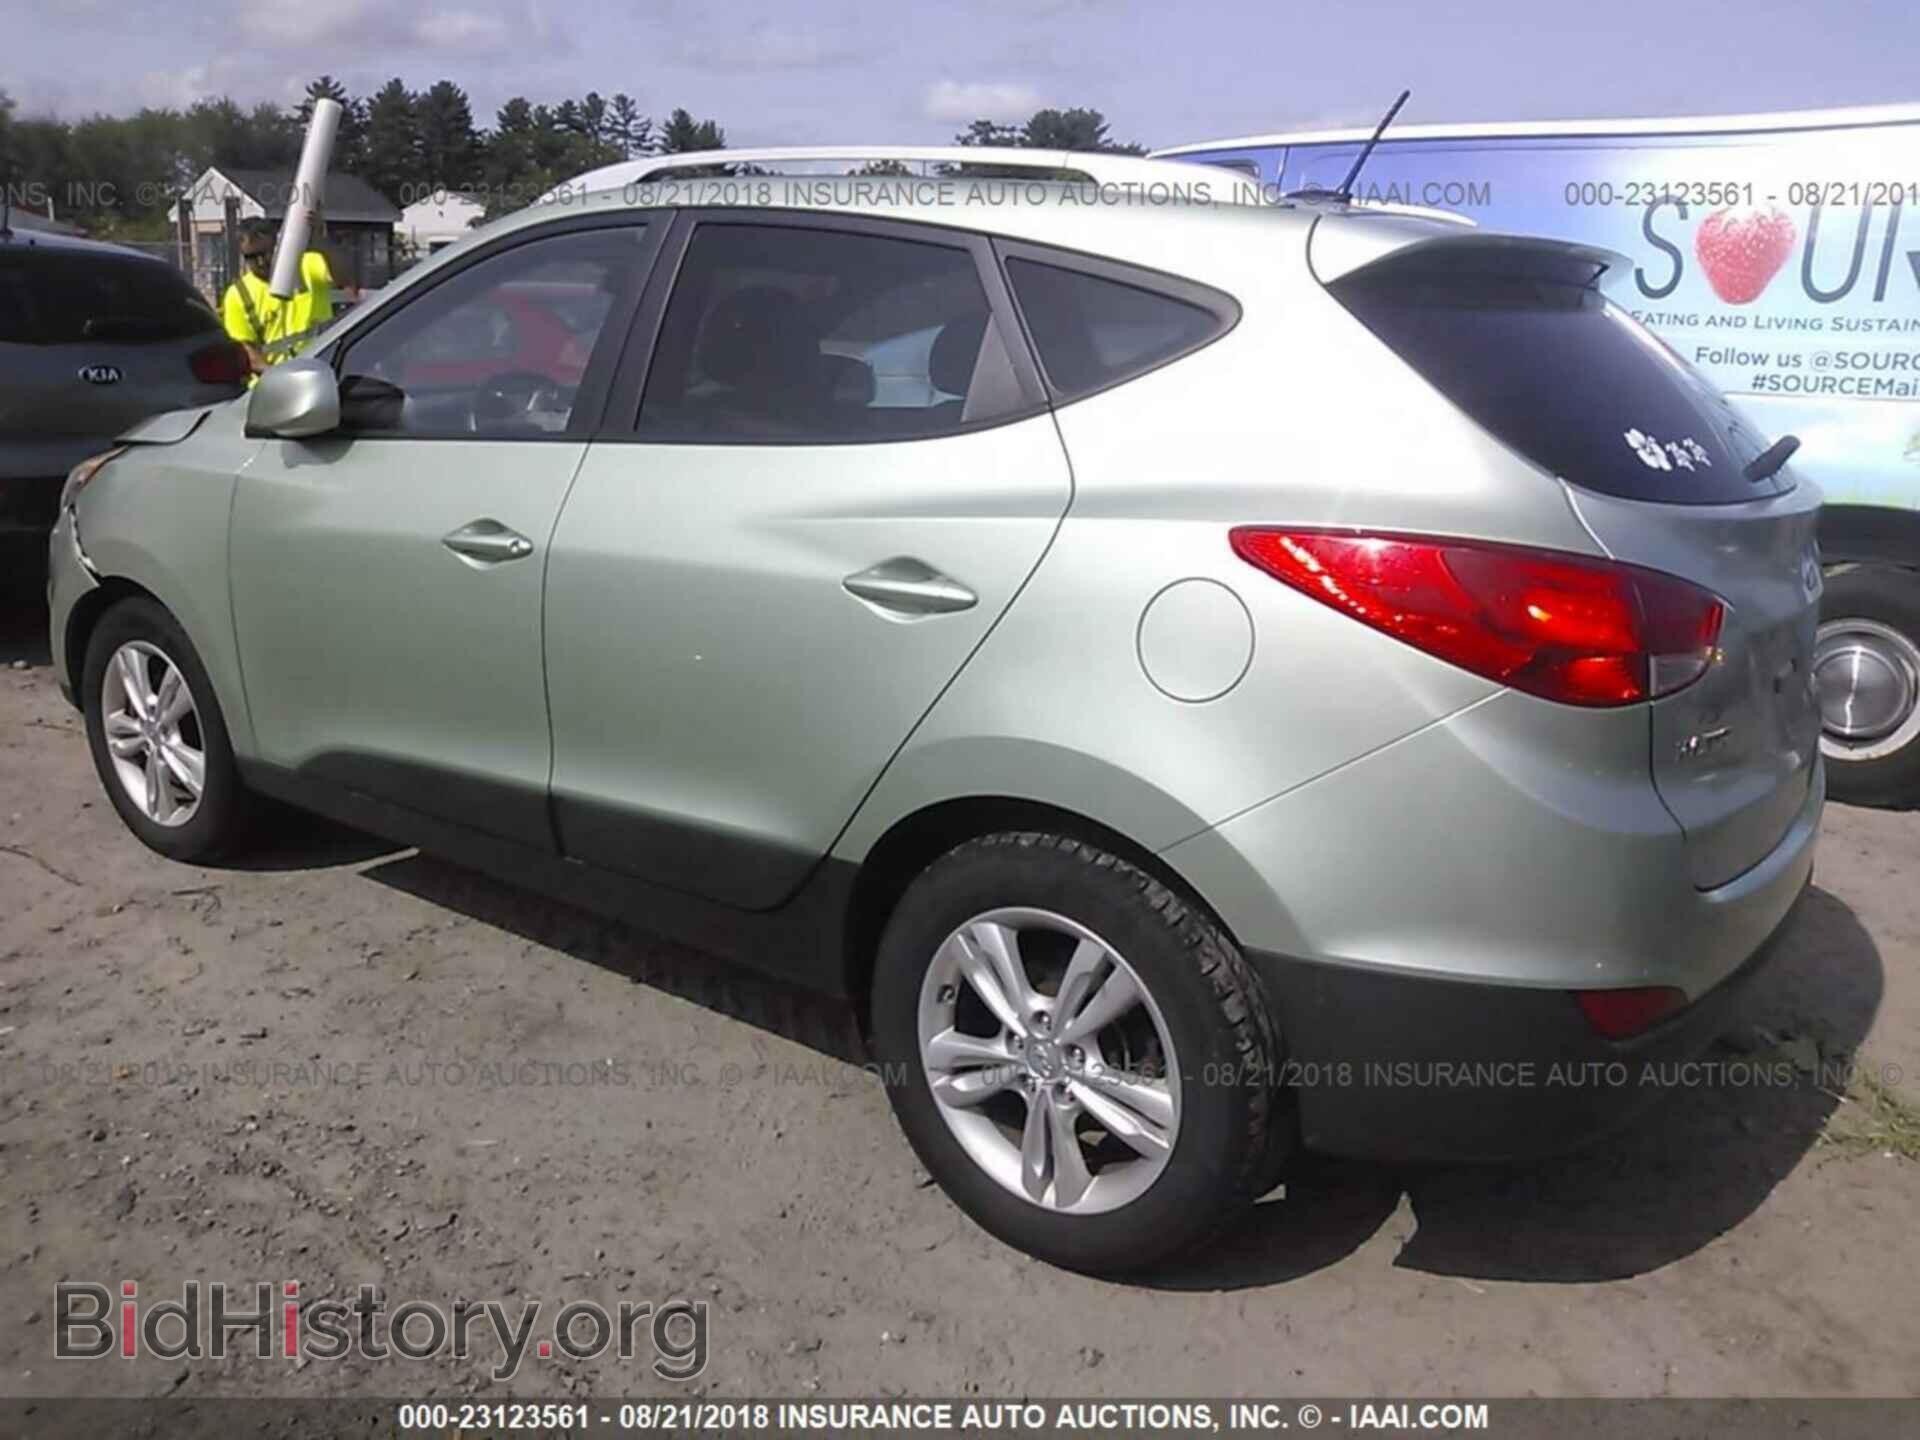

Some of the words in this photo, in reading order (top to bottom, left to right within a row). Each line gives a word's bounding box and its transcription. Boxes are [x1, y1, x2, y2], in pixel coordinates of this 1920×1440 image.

[1705, 315, 1748, 328] AND
[1754, 315, 1823, 331] LIVING
[1695, 346, 1770, 367] Follow
[1777, 353, 1803, 368] us
[88, 367, 120, 381] KIA
